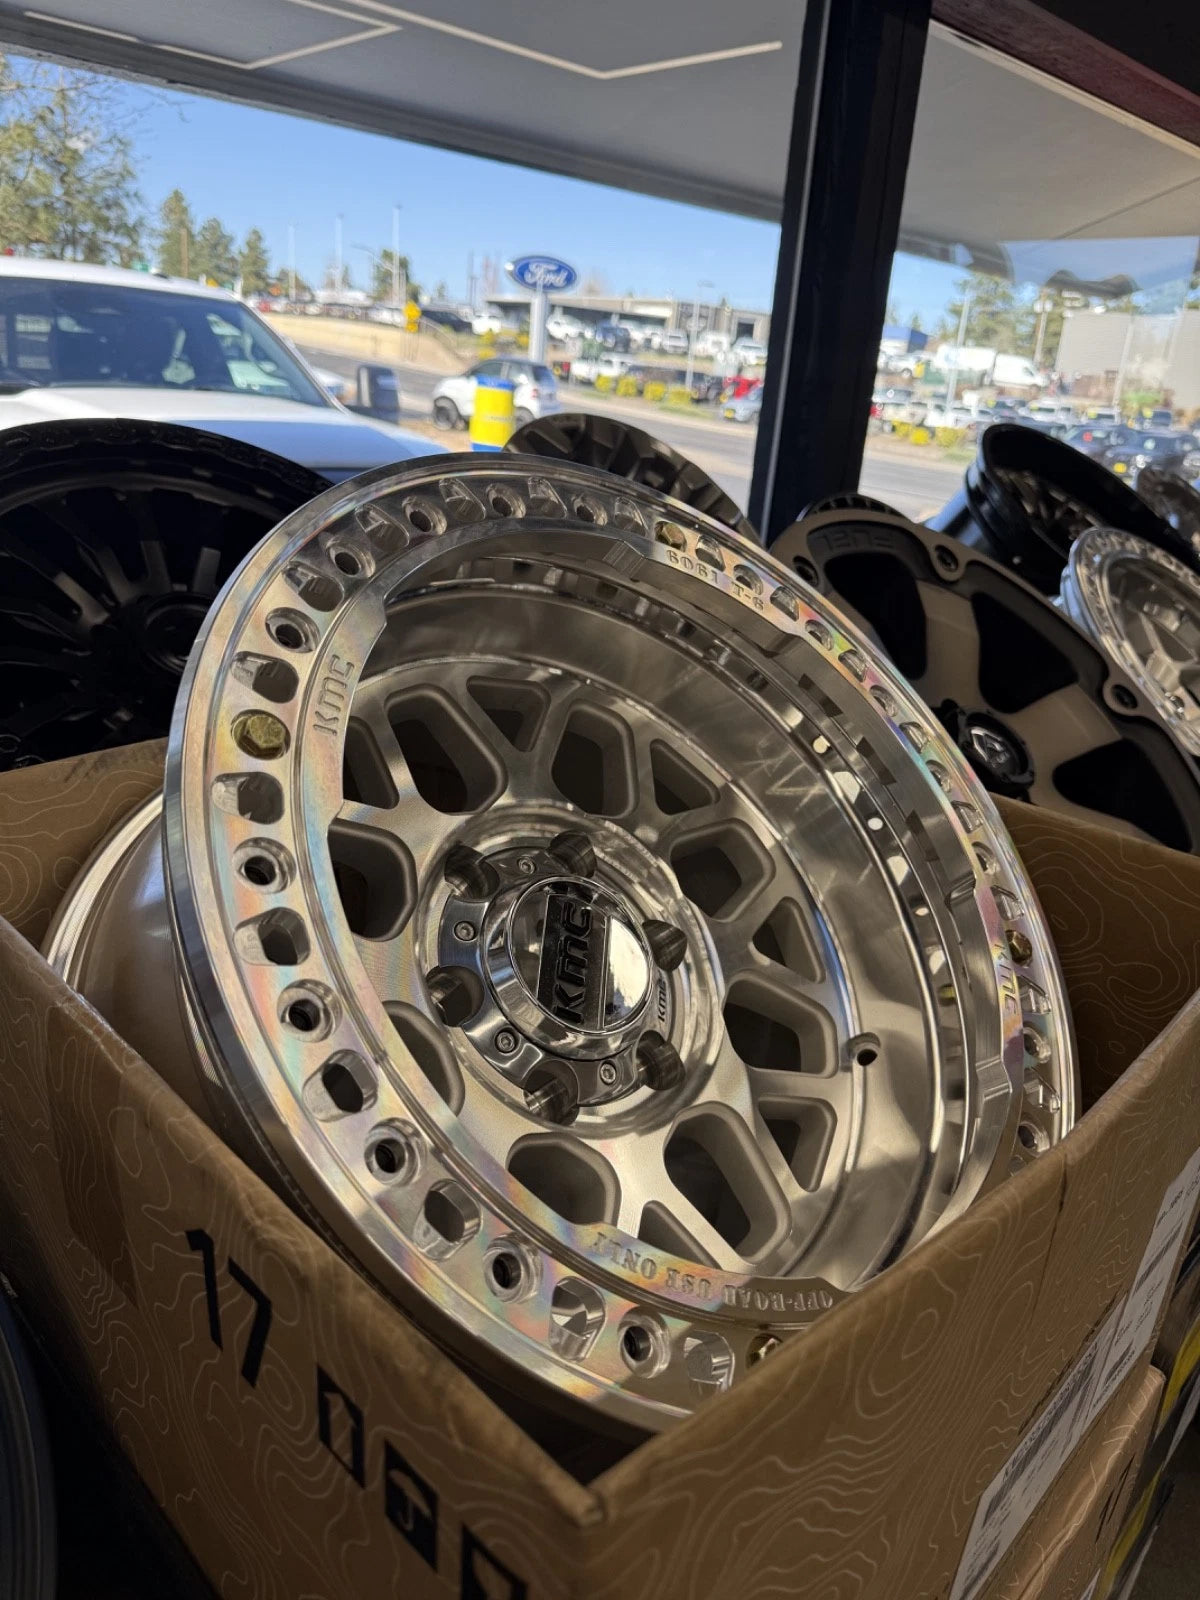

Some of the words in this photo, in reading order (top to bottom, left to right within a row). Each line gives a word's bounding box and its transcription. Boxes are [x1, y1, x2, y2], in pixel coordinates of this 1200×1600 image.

[523, 262, 568, 288] Ford
[817, 529, 895, 552] FUEL
[666, 549, 719, 585] 6061
[731, 580, 764, 611] T-6
[590, 1232, 657, 1281] ONLY
[665, 1266, 713, 1299] USE
[723, 1284, 834, 1312] OFF-ROAD
[186, 1229, 272, 1389] 17
